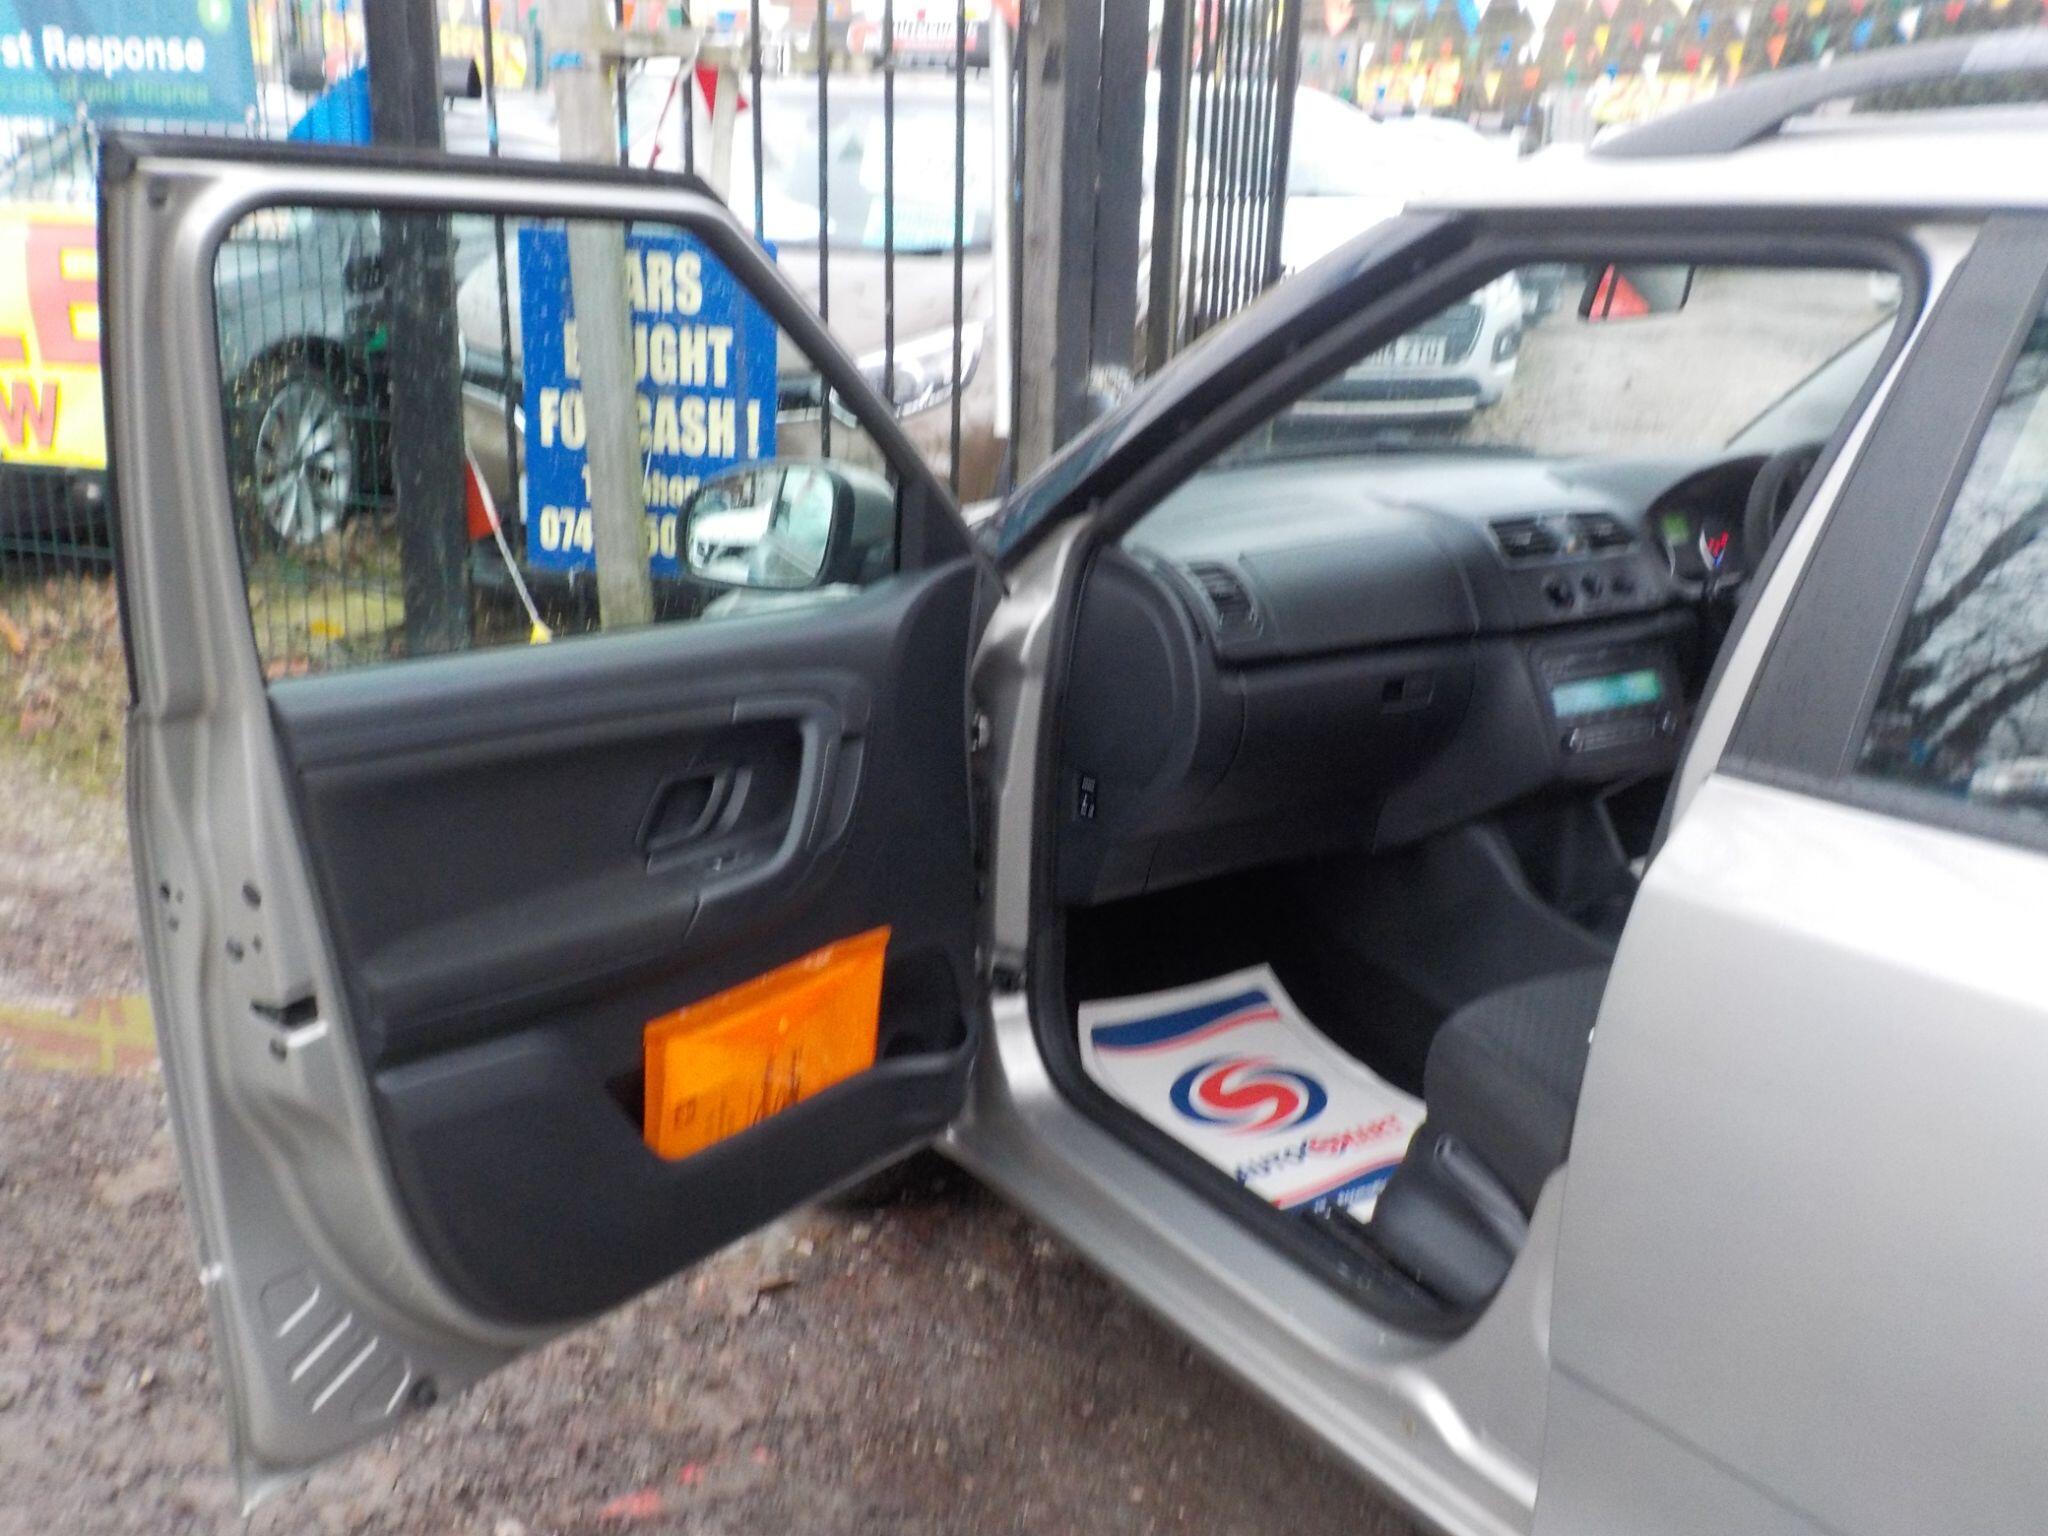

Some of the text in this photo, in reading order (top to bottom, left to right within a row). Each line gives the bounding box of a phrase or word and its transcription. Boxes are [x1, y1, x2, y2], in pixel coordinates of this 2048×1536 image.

[42, 24, 205, 79] Response
[625, 249, 702, 315] ARS
[539, 386, 588, 450] FO
